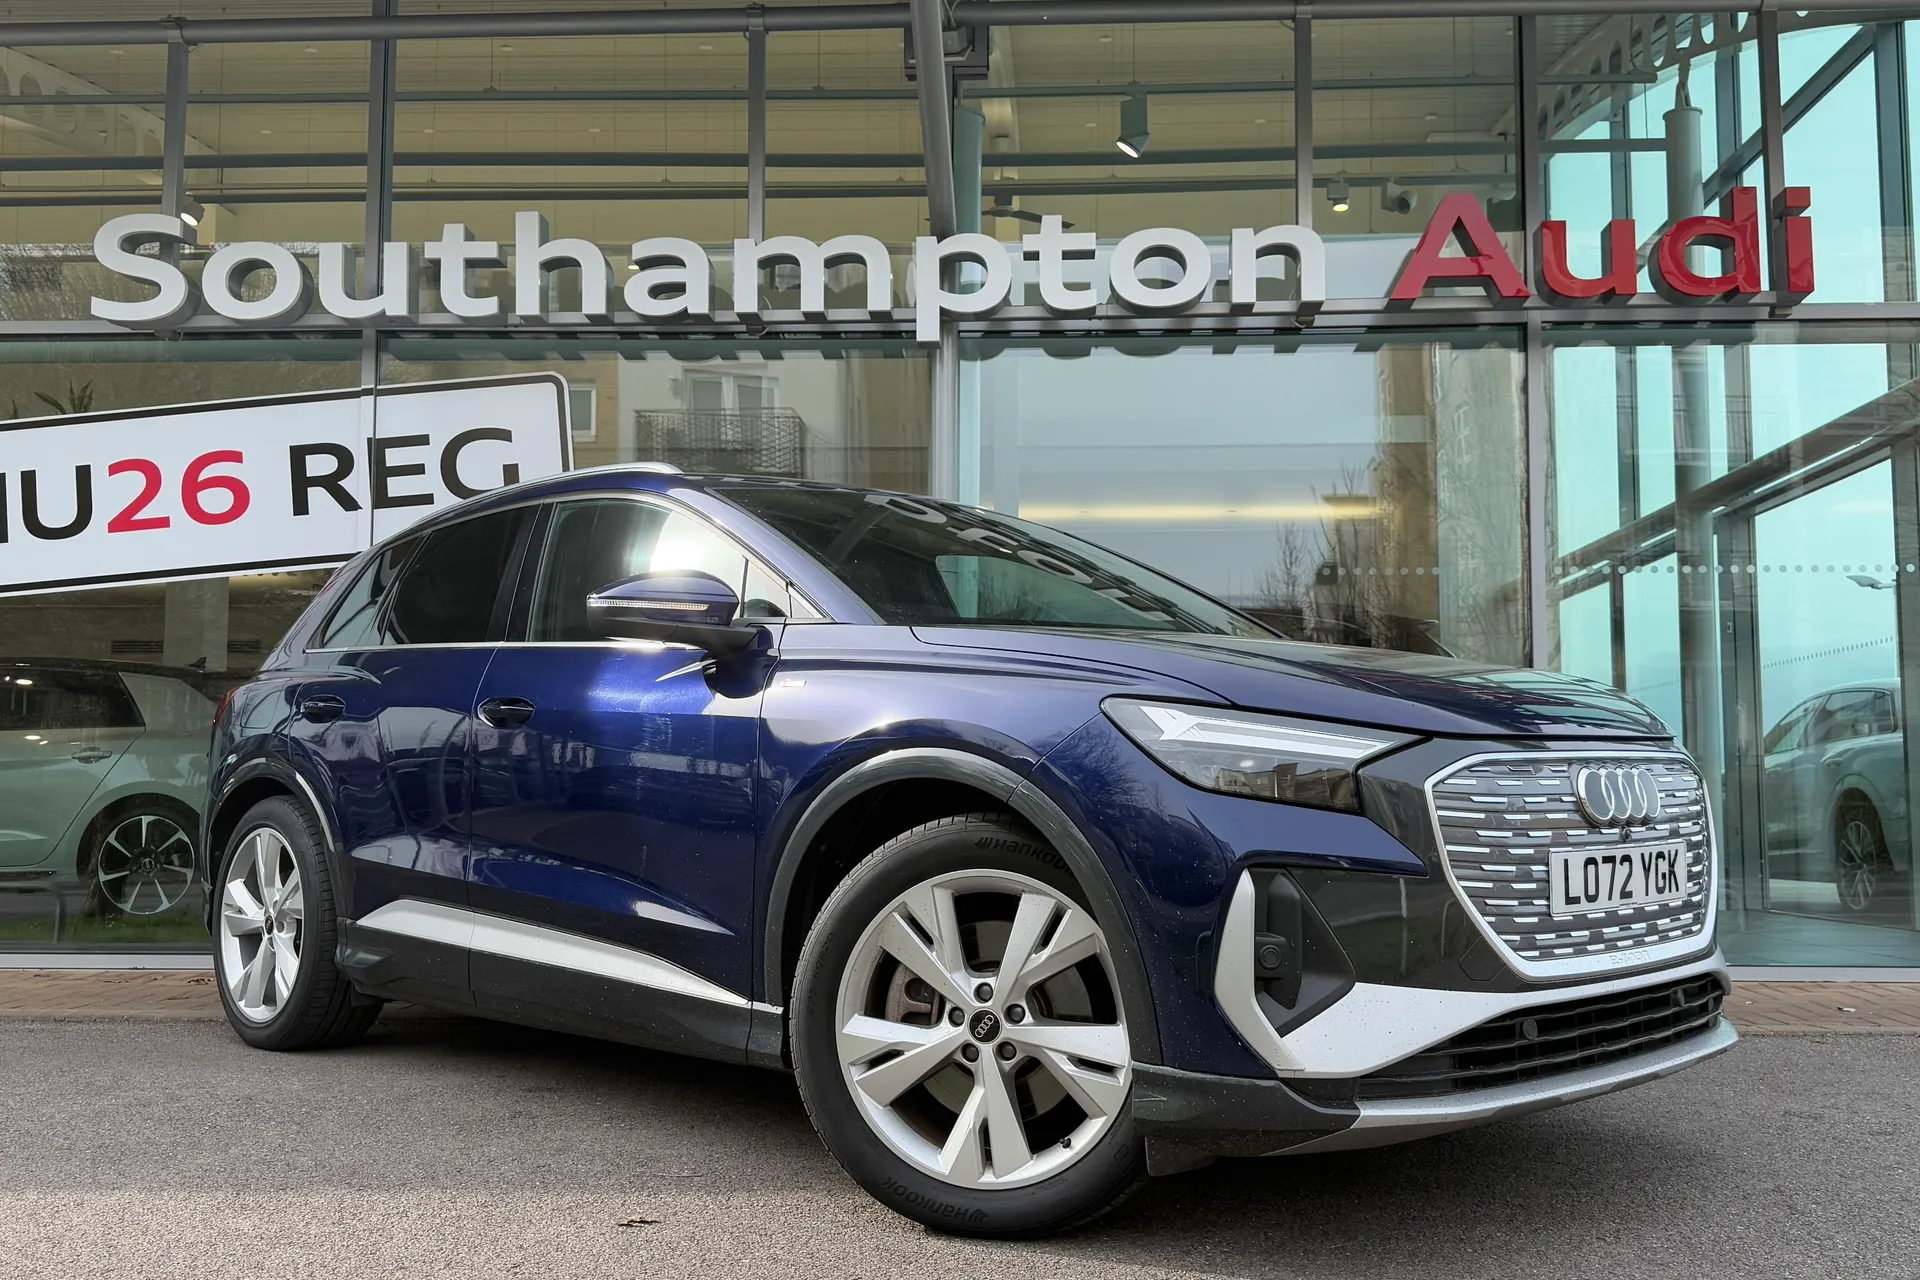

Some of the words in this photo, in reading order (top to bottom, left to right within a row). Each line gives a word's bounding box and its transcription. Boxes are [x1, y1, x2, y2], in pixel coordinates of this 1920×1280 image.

[90, 211, 1326, 342] Southampton
[1390, 186, 1815, 301] Audi
[0, 449, 251, 544] U26
[289, 427, 521, 517] REG
[1563, 854, 1634, 906] LO72
[1640, 848, 1681, 897] YGK
